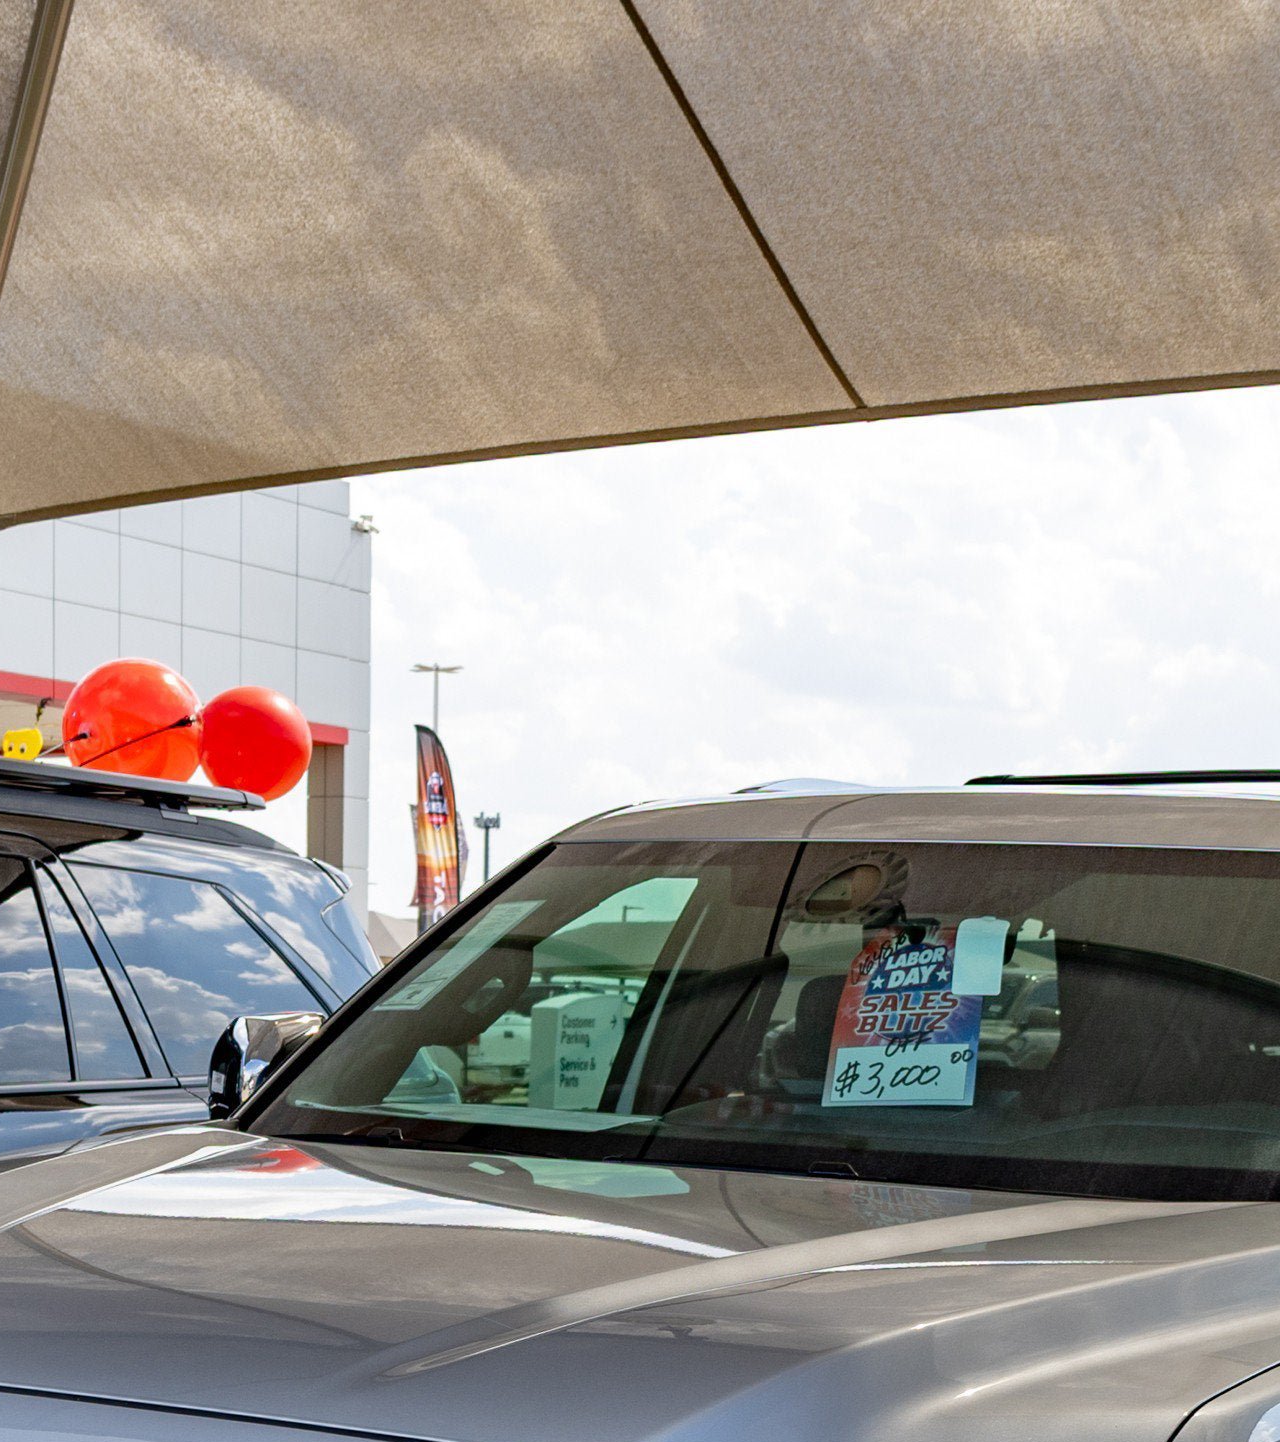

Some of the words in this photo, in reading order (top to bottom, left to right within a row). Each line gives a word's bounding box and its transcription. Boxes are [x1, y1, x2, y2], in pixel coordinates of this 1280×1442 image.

[885, 946, 946, 971] LABOR
[887, 964, 934, 989] DAY
[859, 991, 959, 1015] SALES
[561, 1014, 596, 1030] Customer
[856, 1010, 950, 1034] BLITZ
[560, 1030, 591, 1048] Parking
[885, 1030, 935, 1057] OFF
[559, 1056, 588, 1072] Service
[559, 1073, 579, 1088] Parts
